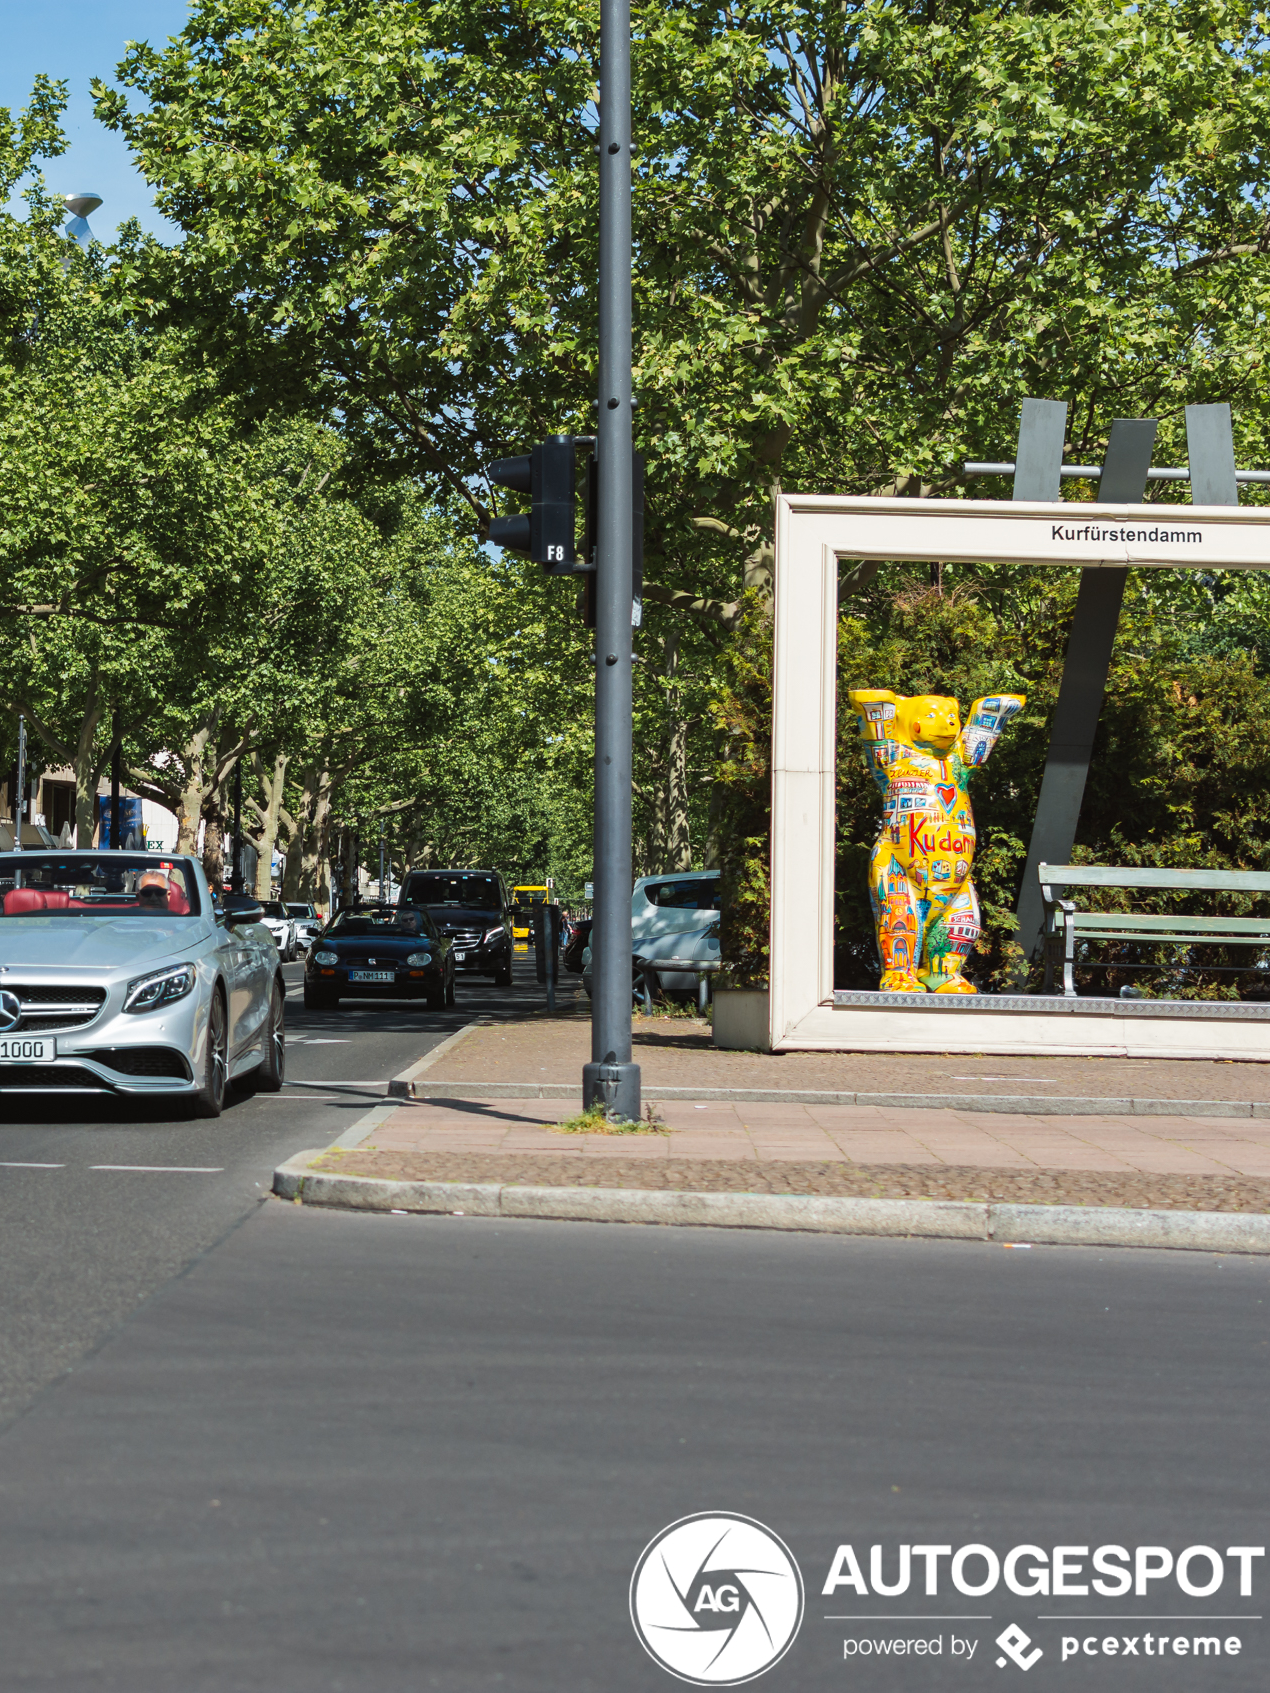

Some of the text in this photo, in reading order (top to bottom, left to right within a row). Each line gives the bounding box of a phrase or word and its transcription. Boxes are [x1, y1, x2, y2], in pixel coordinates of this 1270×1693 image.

[1052, 525, 1202, 543] Kurfürstendamm
[547, 545, 564, 561] F8
[363, 972, 373, 980] NM
[375, 972, 388, 980] 111
[0, 1042, 43, 1058] 1000
